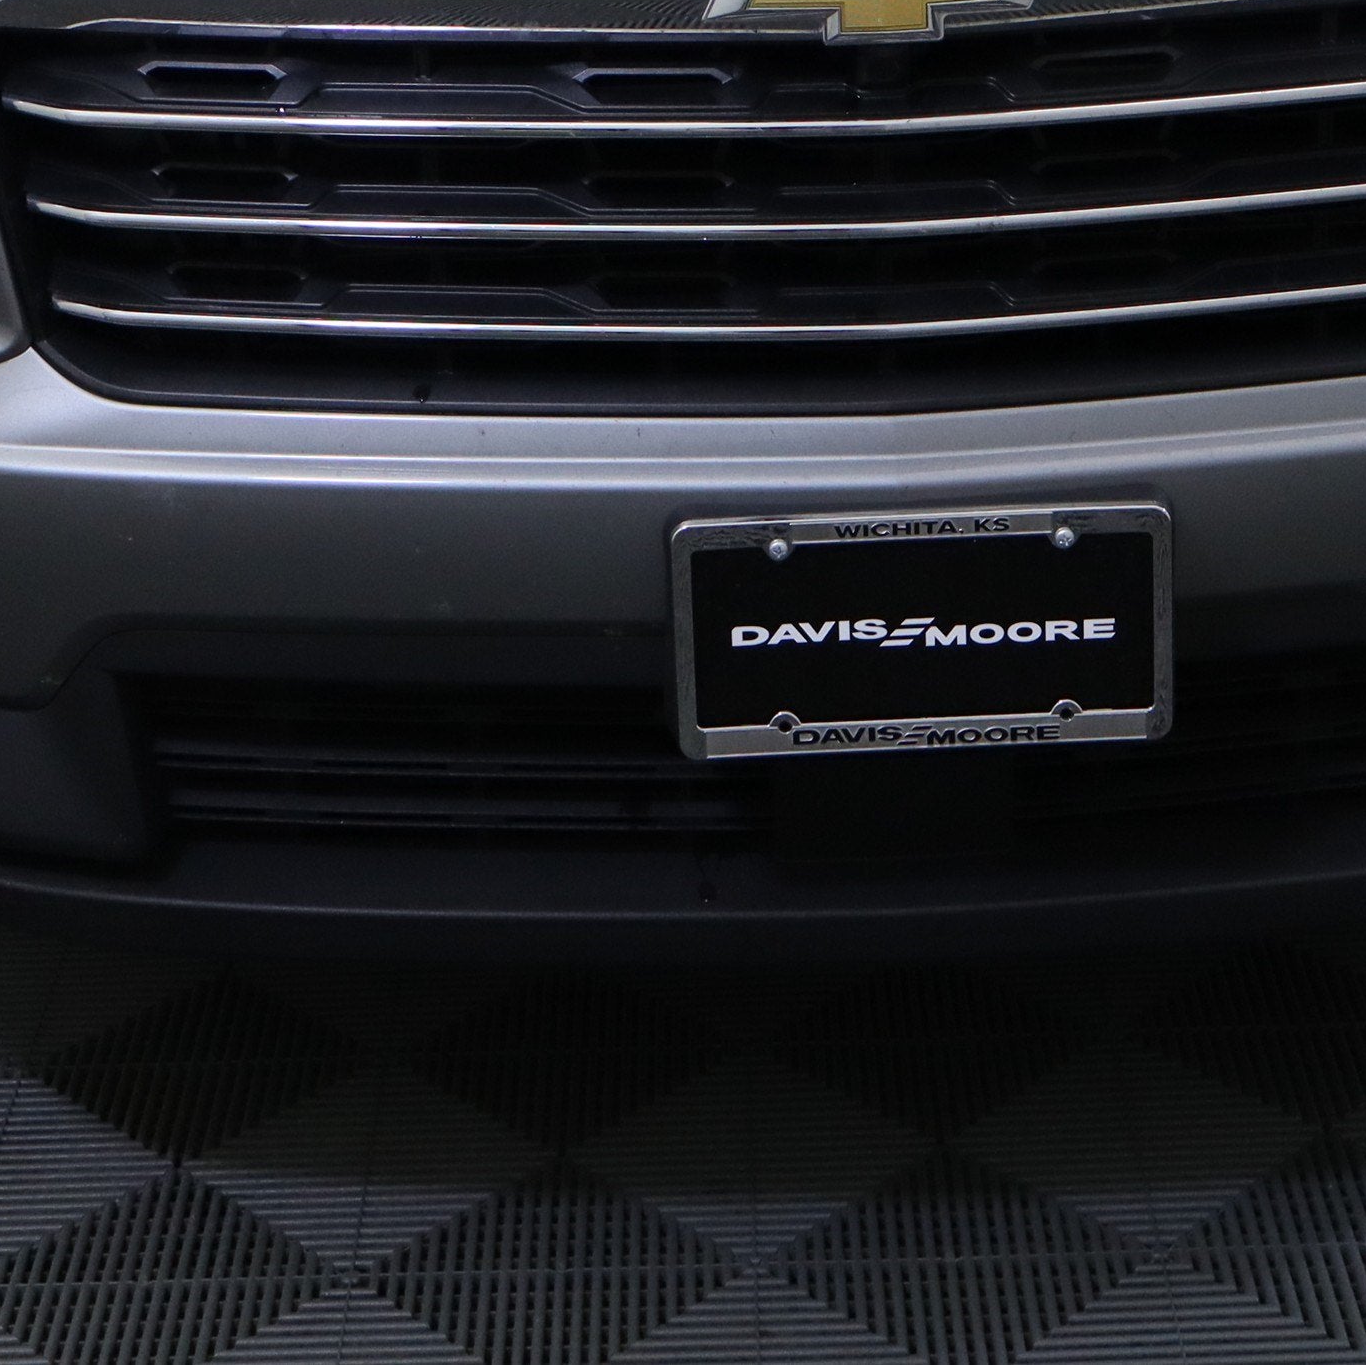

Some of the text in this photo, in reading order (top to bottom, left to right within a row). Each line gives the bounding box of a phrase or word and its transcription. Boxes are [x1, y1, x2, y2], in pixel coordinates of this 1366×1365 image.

[974, 517, 1010, 533] KS
[731, 617, 1116, 647] DAVIS MOORE
[792, 724, 1061, 746] DAVIS MOORE
